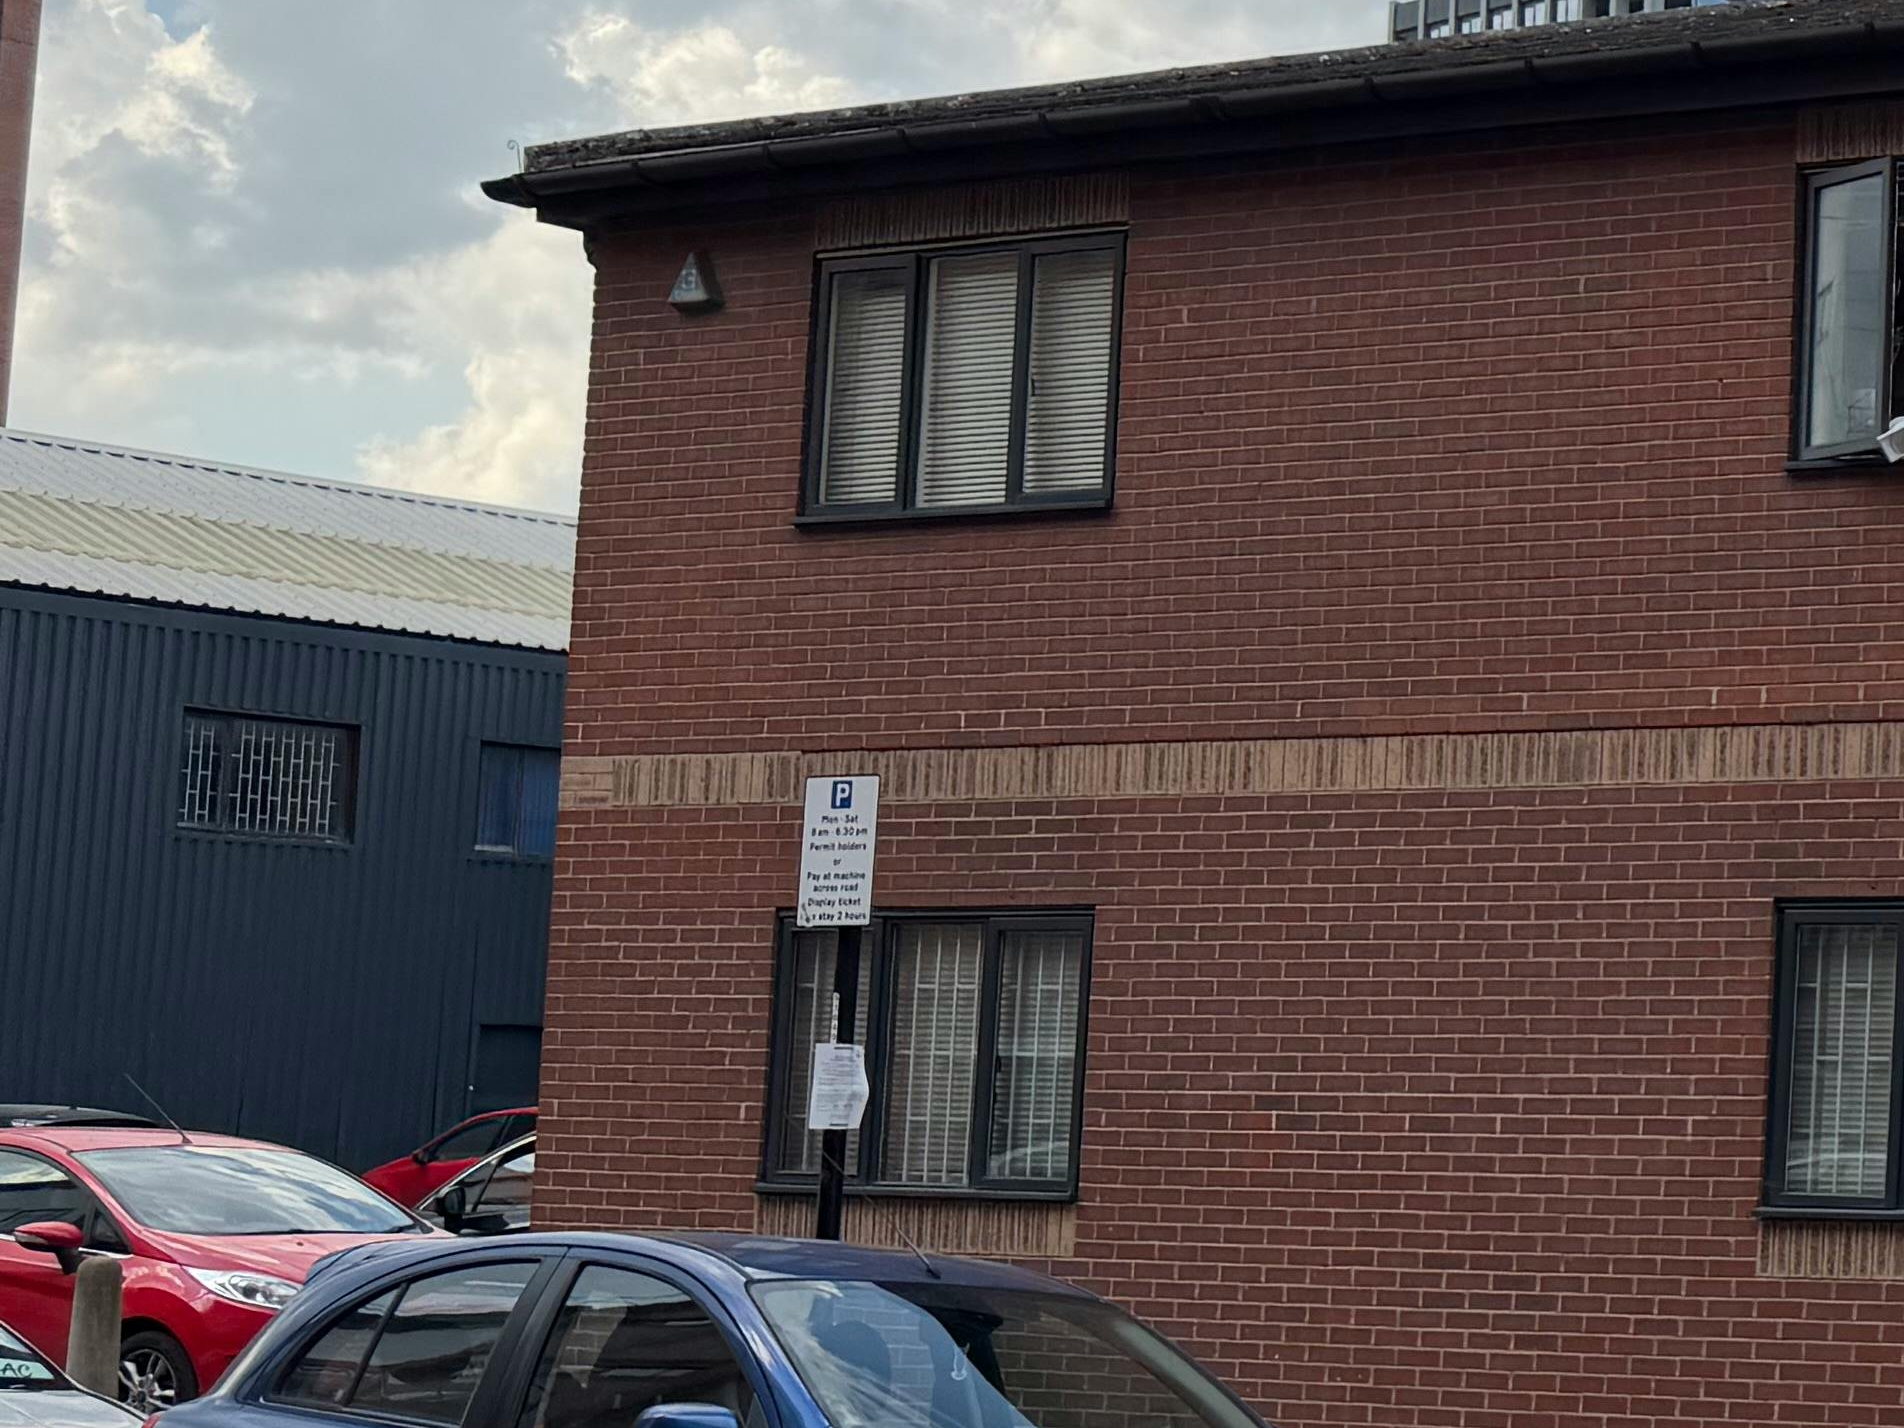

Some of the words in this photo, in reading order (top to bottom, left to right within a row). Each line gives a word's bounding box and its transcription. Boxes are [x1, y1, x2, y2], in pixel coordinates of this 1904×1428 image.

[835, 783, 850, 807] P
[810, 842, 836, 851] Permit
[838, 841, 867, 850] holders
[833, 858, 841, 866] or
[807, 872, 820, 882] Pay
[823, 872, 831, 880] at
[833, 872, 866, 880] machine
[840, 883, 859, 892] road
[807, 897, 836, 907] Display
[838, 897, 861, 906] ticket
[844, 911, 866, 920] hours
